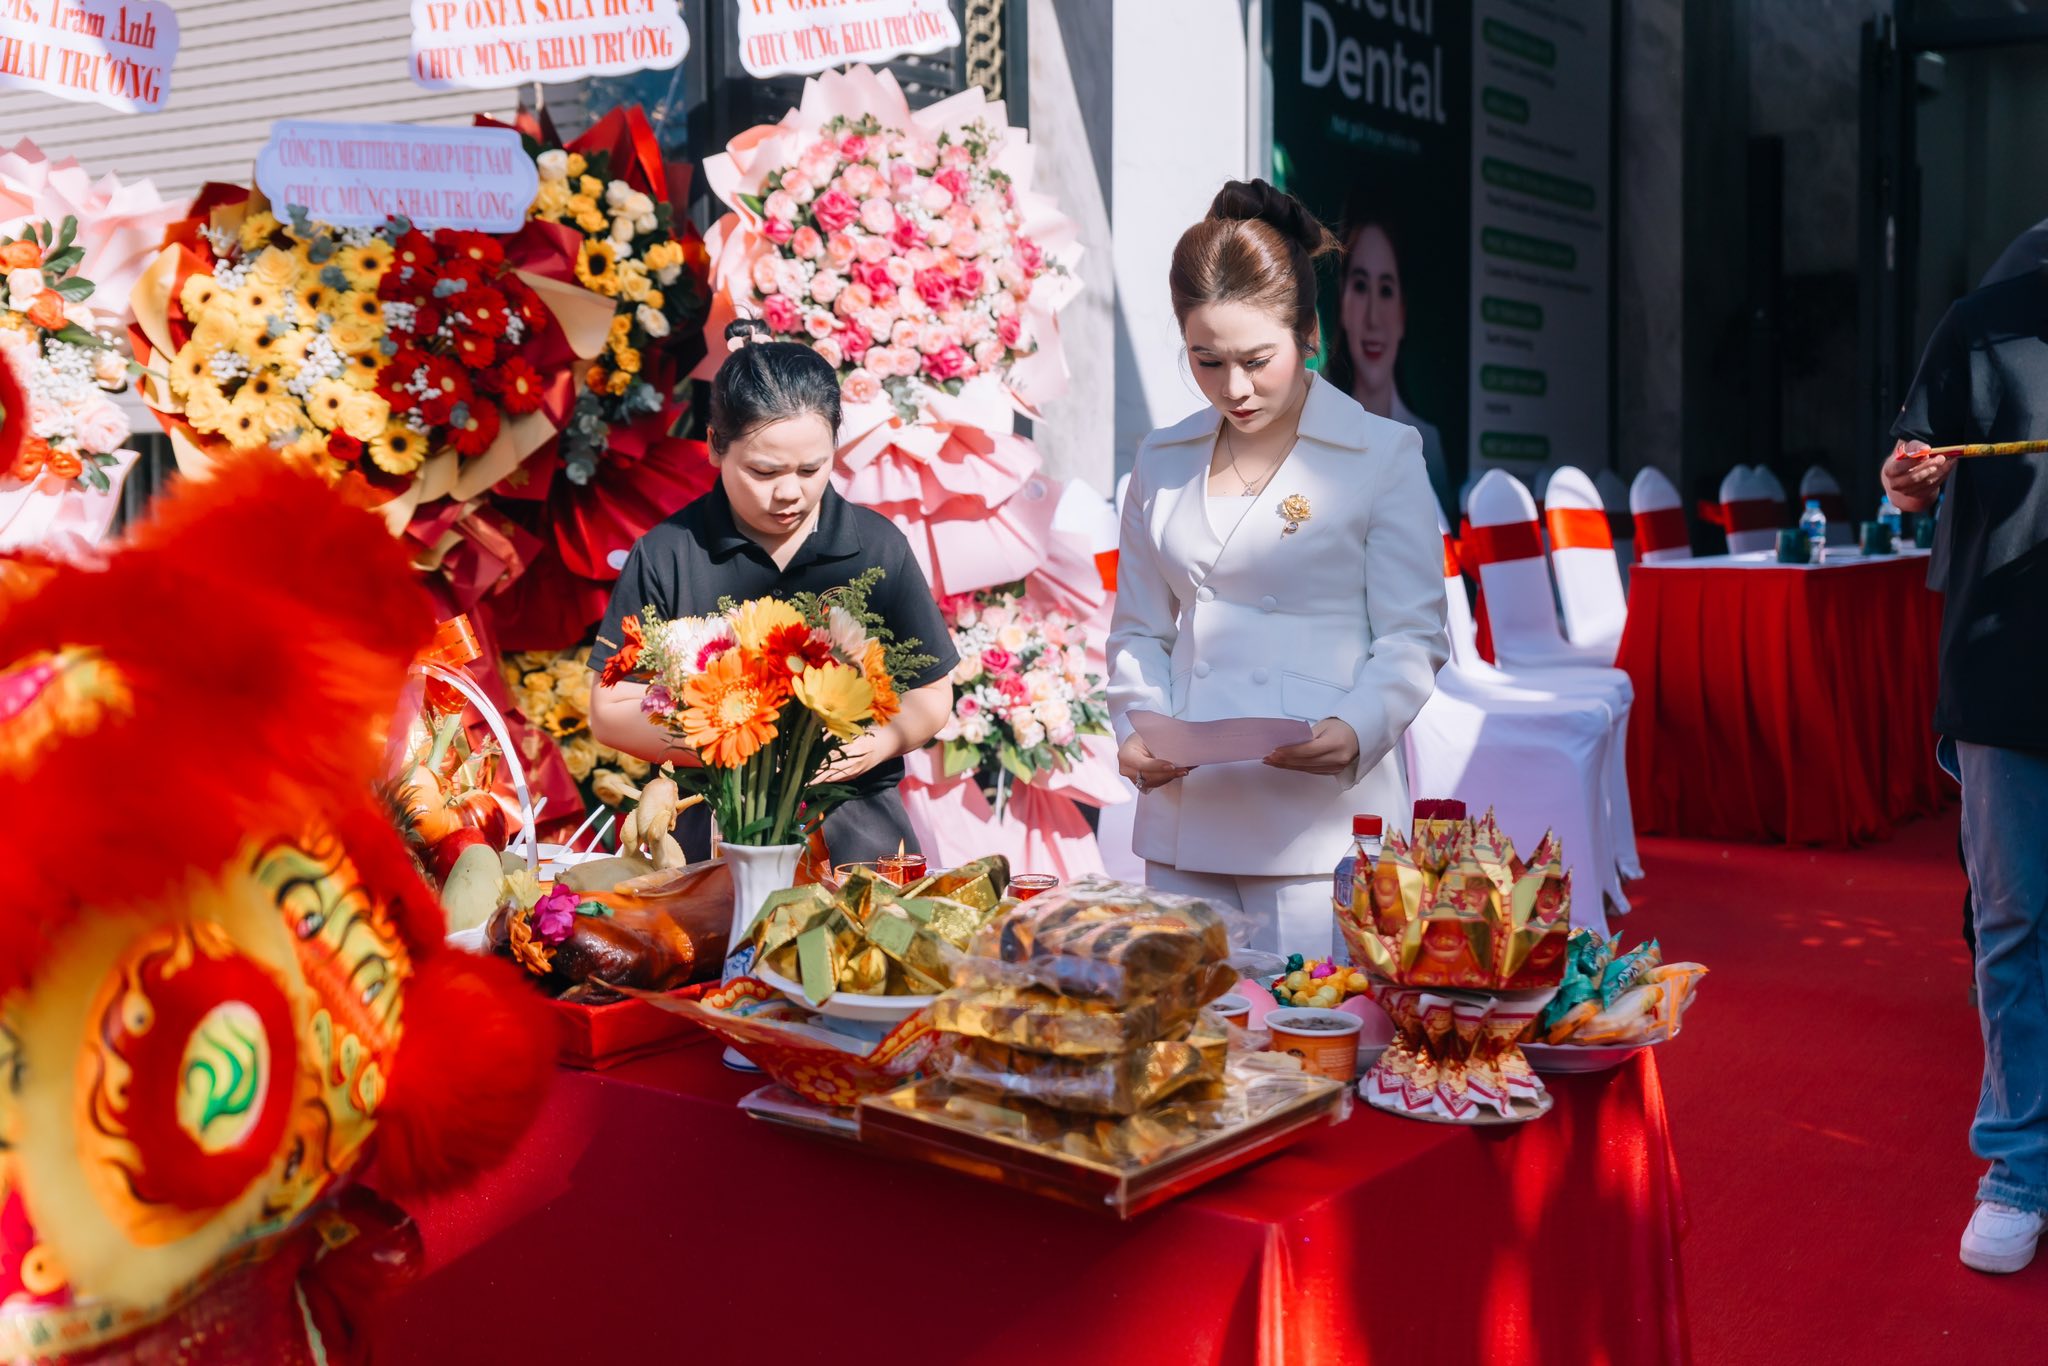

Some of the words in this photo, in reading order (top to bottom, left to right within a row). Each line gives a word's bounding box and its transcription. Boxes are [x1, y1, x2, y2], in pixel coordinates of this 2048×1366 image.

[111, 5, 157, 49] Anh
[426, 3, 457, 32] VP
[536, 35, 586, 71] KHAI
[841, 19, 882, 55] KHAI
[0, 36, 50, 82] HAI
[1301, 1, 1447, 125] Dental
[319, 138, 334, 169] TY
[412, 142, 453, 174] GROUP
[485, 144, 513, 176] NAM
[396, 187, 439, 218] KHAI
